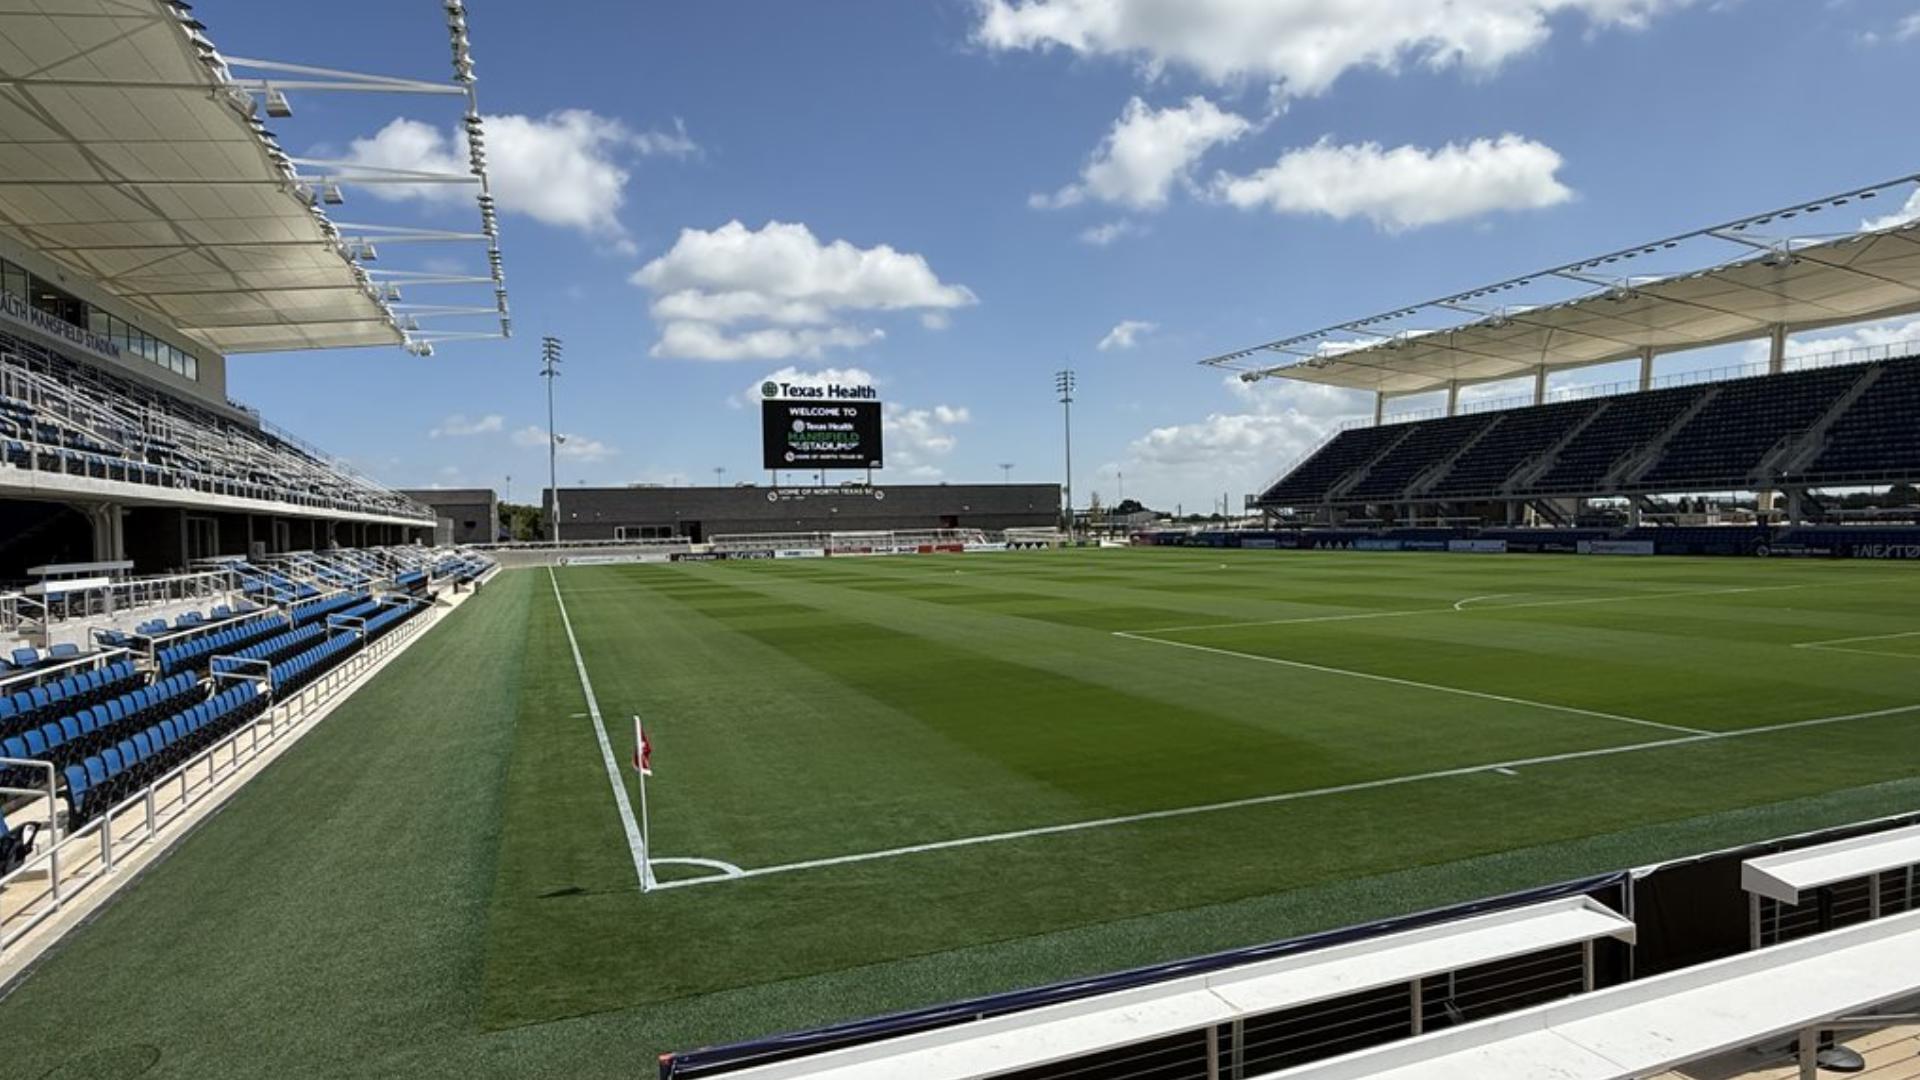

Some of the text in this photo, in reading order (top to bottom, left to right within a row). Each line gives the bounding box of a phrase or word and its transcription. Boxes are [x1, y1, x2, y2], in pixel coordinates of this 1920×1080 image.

[30, 305, 83, 344] MANSFIELD
[780, 383, 876, 398] Texas Health
[789, 407, 857, 416] WELCOME TO
[806, 422, 827, 430] Texas
[787, 432, 860, 442] MANSFIELD
